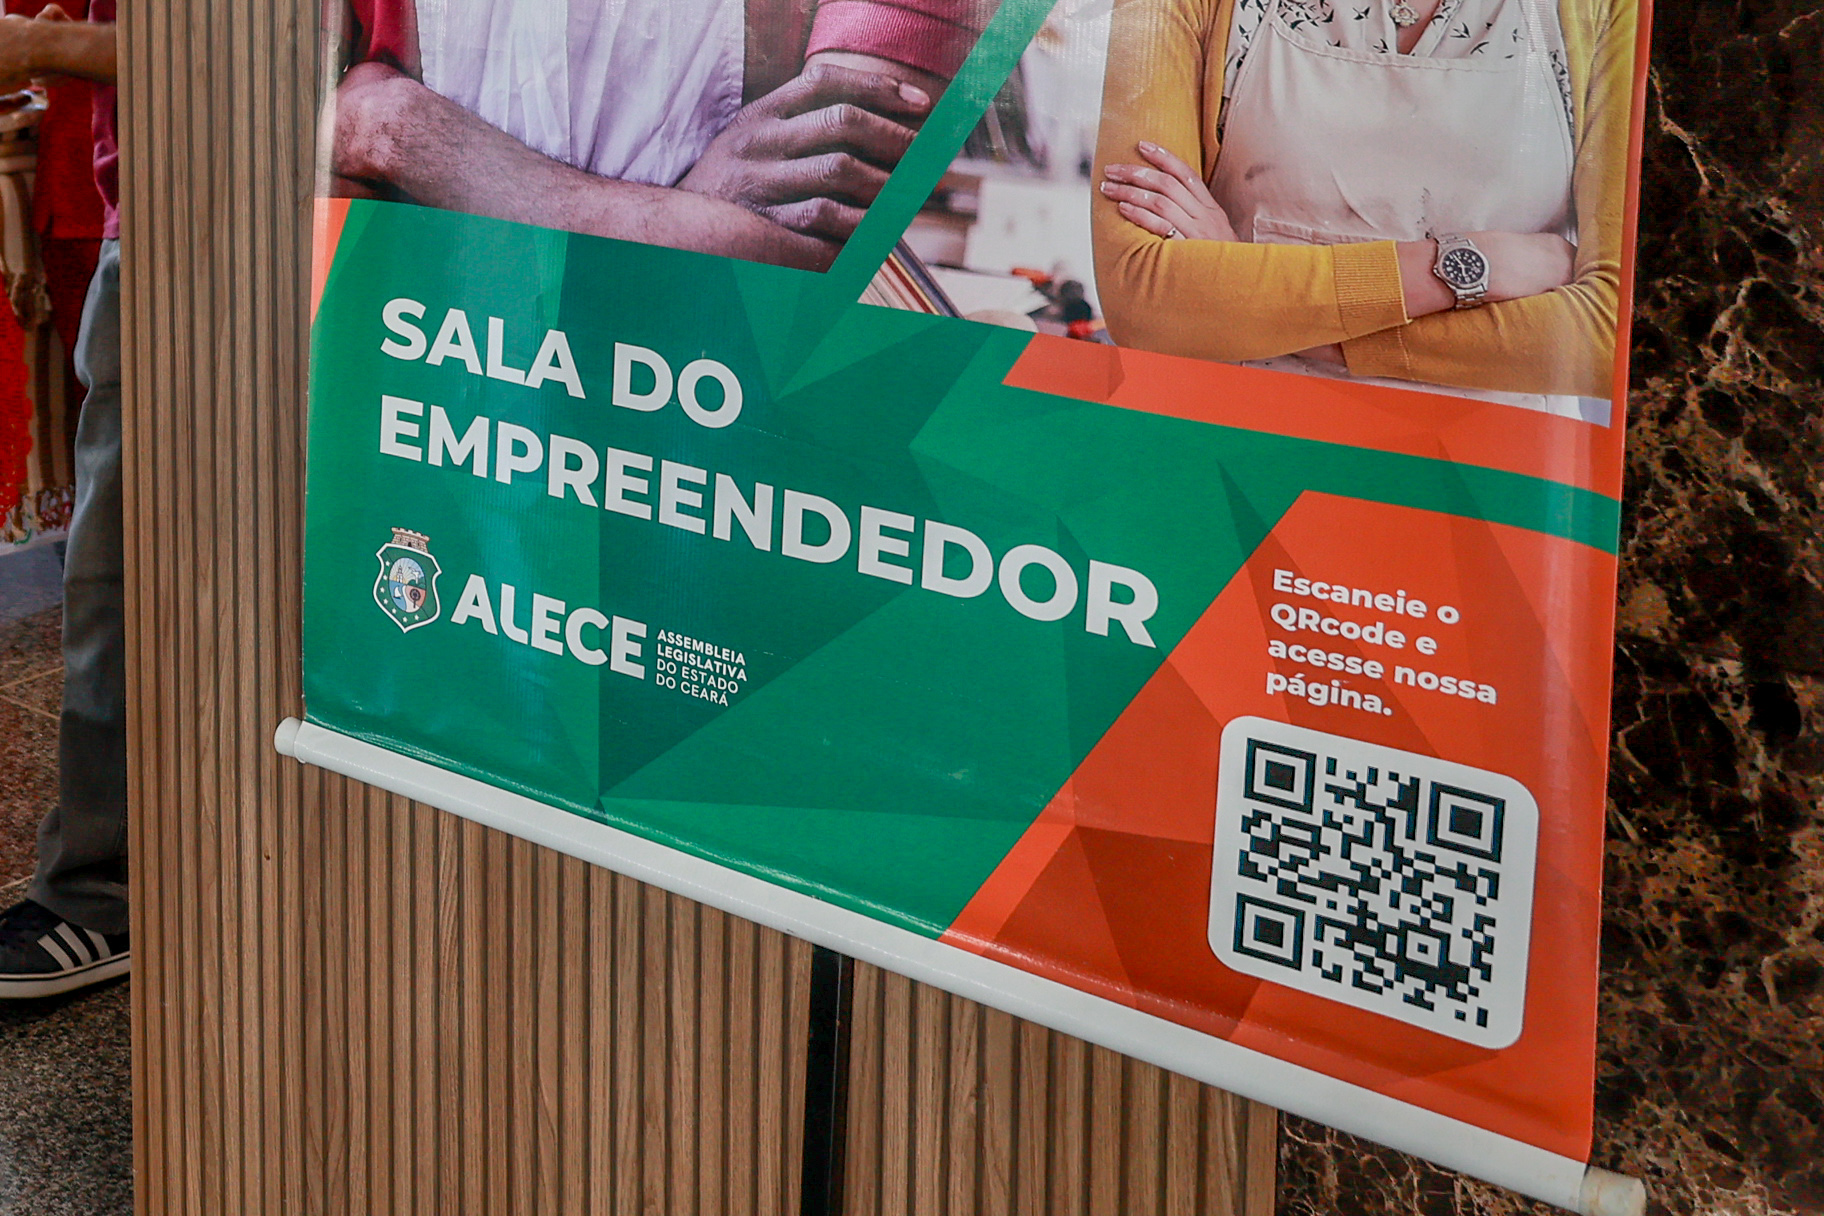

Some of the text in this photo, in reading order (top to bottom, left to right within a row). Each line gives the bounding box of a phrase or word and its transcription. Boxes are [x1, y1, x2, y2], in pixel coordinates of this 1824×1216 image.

[380, 298, 743, 429] SALA DO
[379, 394, 1159, 648] EMPREENDEDOR
[1273, 568, 1460, 625] Escaneie o
[450, 573, 647, 680] ALECE
[657, 629, 746, 666] ASSEMBLEIA
[1270, 603, 1438, 656] QRcode e
[656, 658, 739, 694] DO ESTADO
[657, 643, 747, 682] LEGISLATIVA
[1267, 639, 1498, 705] acesse nossa
[655, 672, 729, 707] DO CEARÁ
[1266, 671, 1393, 716] página.
